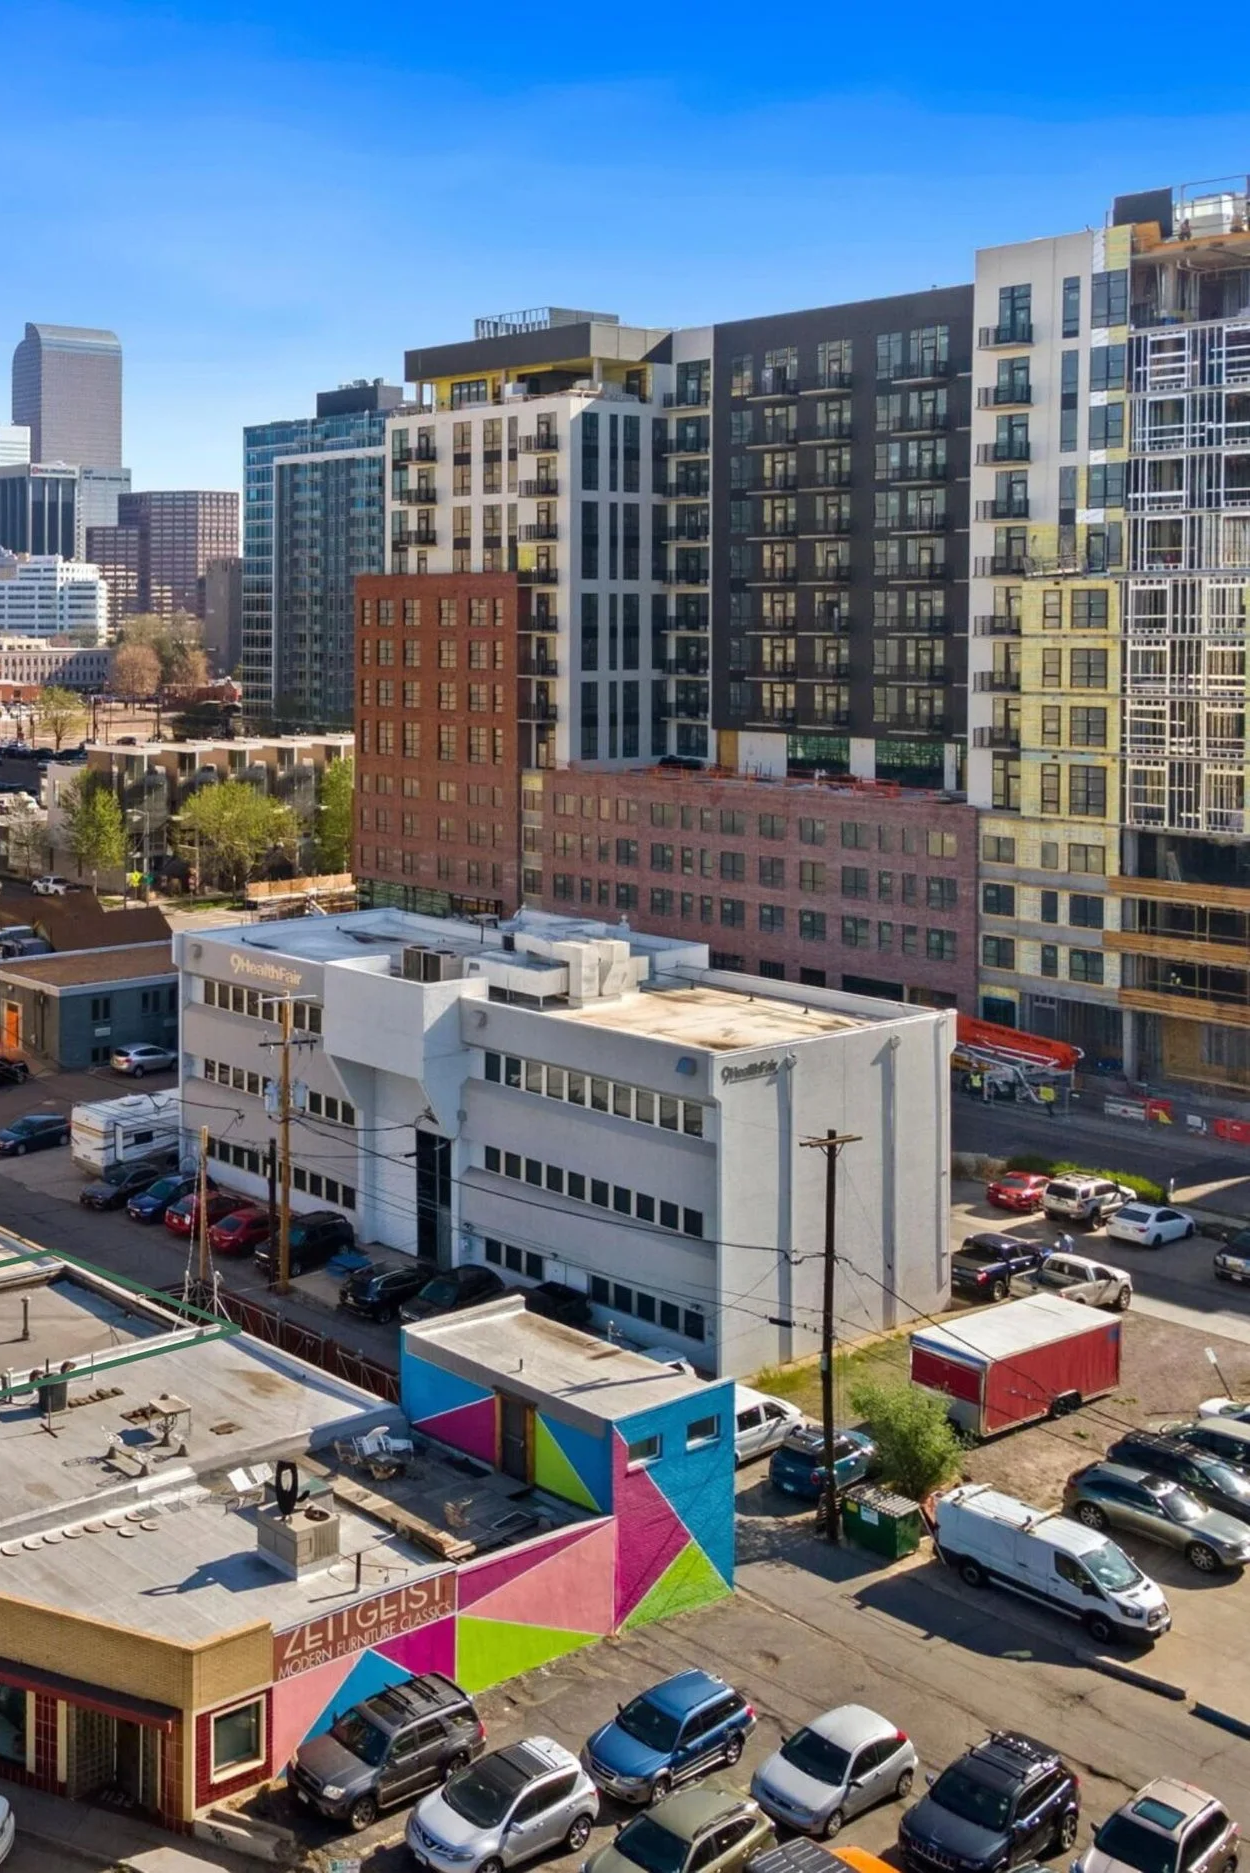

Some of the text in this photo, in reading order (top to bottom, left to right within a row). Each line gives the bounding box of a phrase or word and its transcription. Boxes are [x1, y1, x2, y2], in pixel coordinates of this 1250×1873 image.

[230, 953, 302, 986] 9HealthFair
[278, 1600, 452, 1681] MODERN FURNITURE CLASSICS
